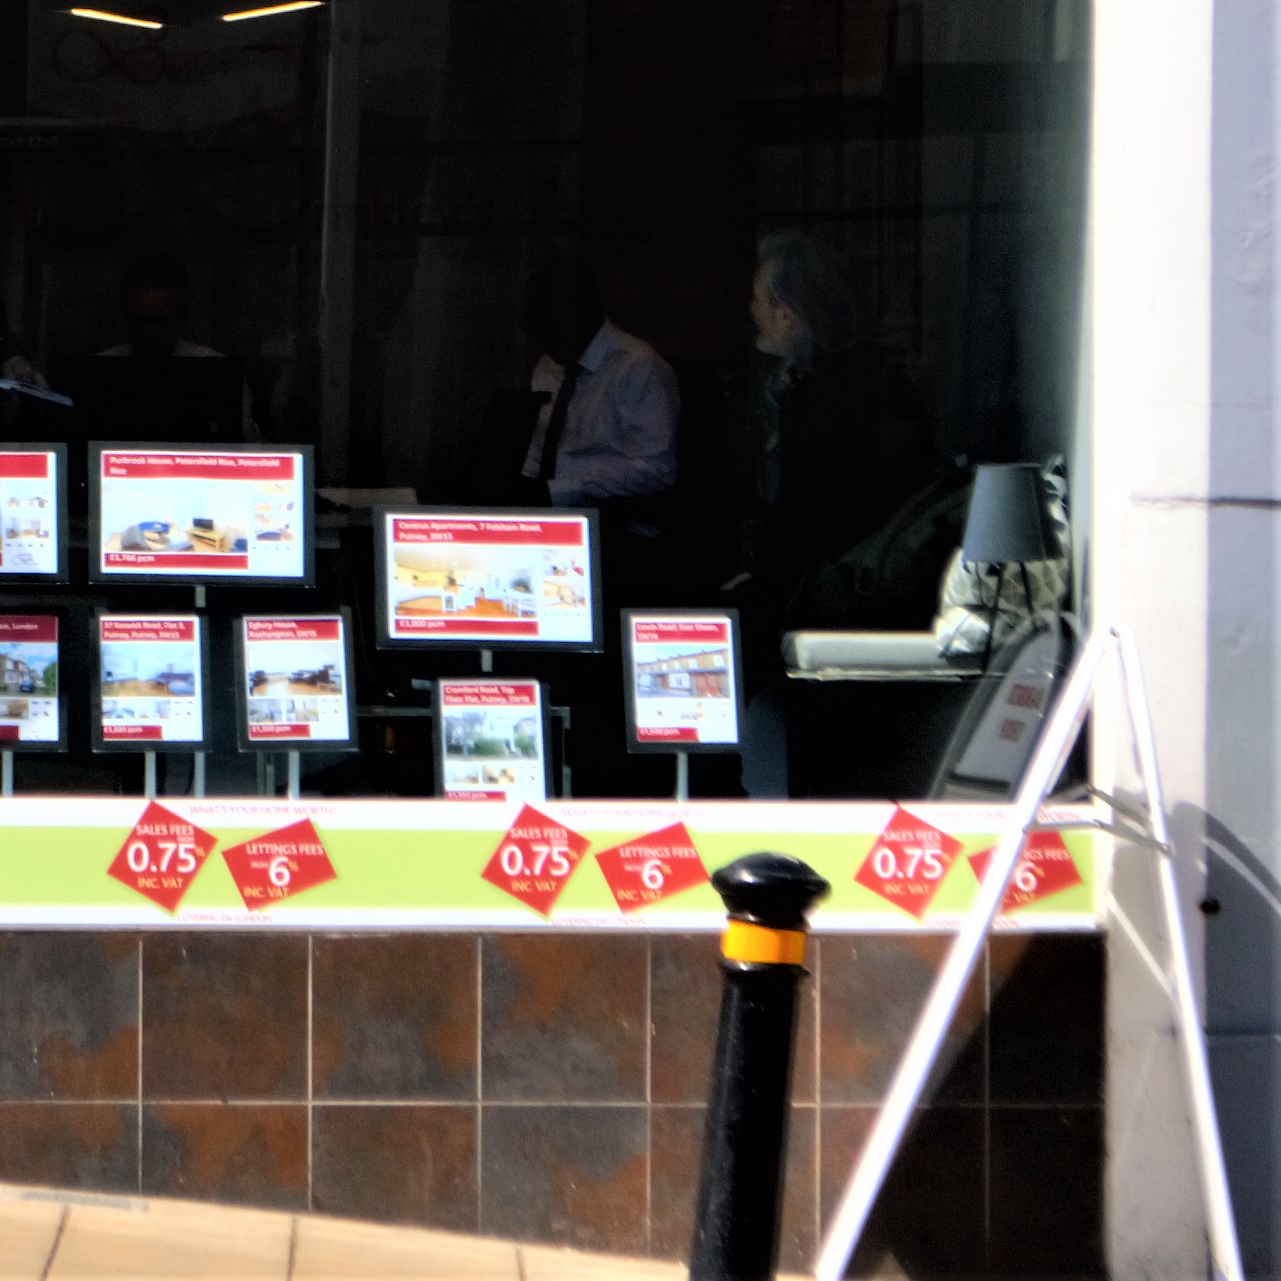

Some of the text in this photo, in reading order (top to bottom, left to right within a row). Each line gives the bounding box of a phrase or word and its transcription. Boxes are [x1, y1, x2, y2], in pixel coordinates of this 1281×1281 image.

[135, 824, 194, 836] SALES FEES
[510, 828, 568, 839] SALES FEES
[246, 844, 324, 855] LETTINGS FEES
[619, 847, 698, 858] LETTINGS FEES
[162, 878, 183, 888] VAT
[536, 881, 557, 892] VAT
[268, 887, 289, 898] VAT
[641, 890, 663, 900] VAT
